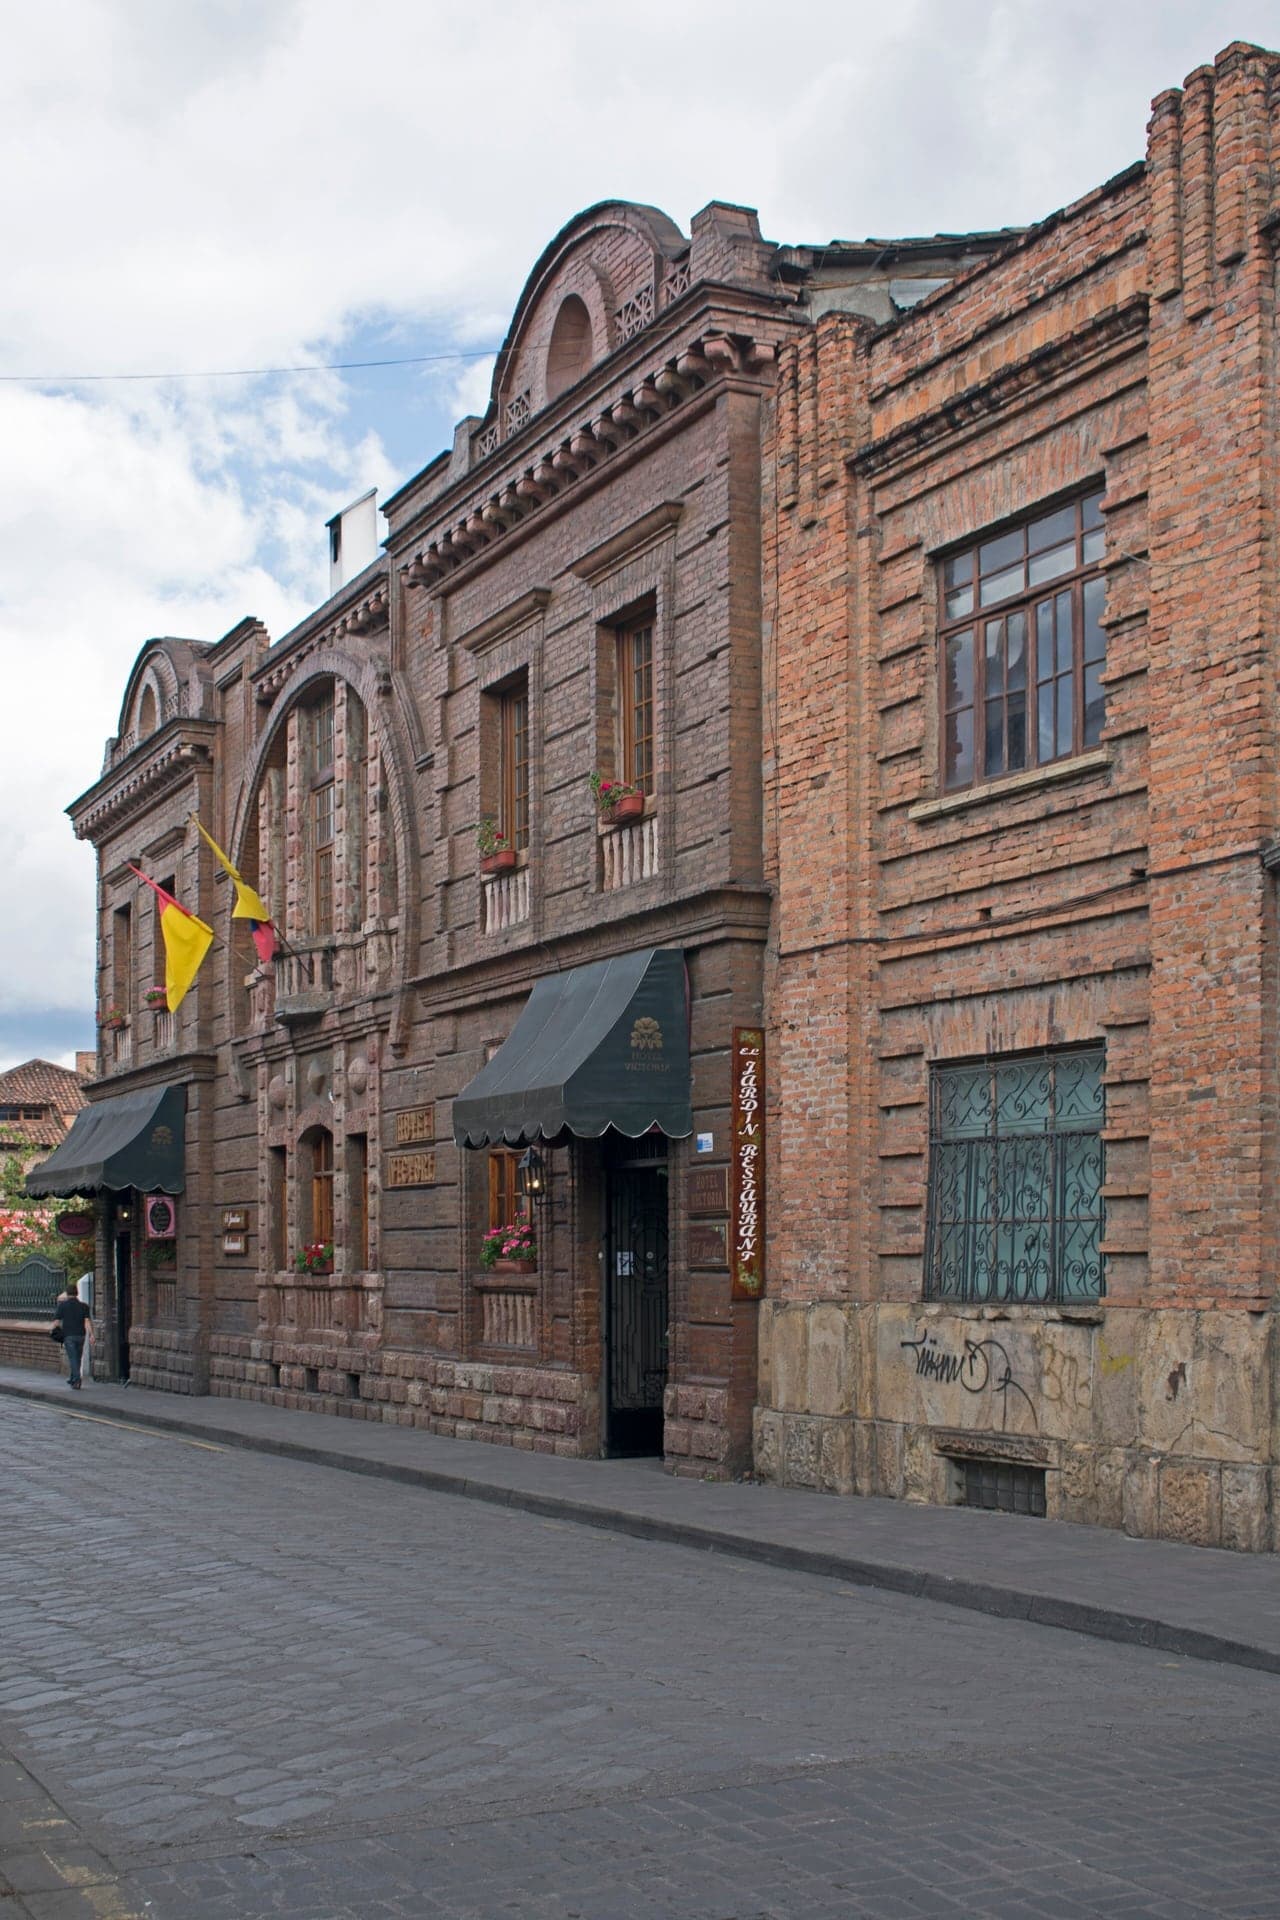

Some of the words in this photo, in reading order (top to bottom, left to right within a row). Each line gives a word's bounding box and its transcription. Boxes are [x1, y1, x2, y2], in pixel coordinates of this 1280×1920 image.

[624, 1062, 672, 1073] VICTORIA
[739, 1047, 760, 1056] EL
[738, 1060, 759, 1136] JARDIN
[736, 1144, 759, 1262] RESTAURANT
